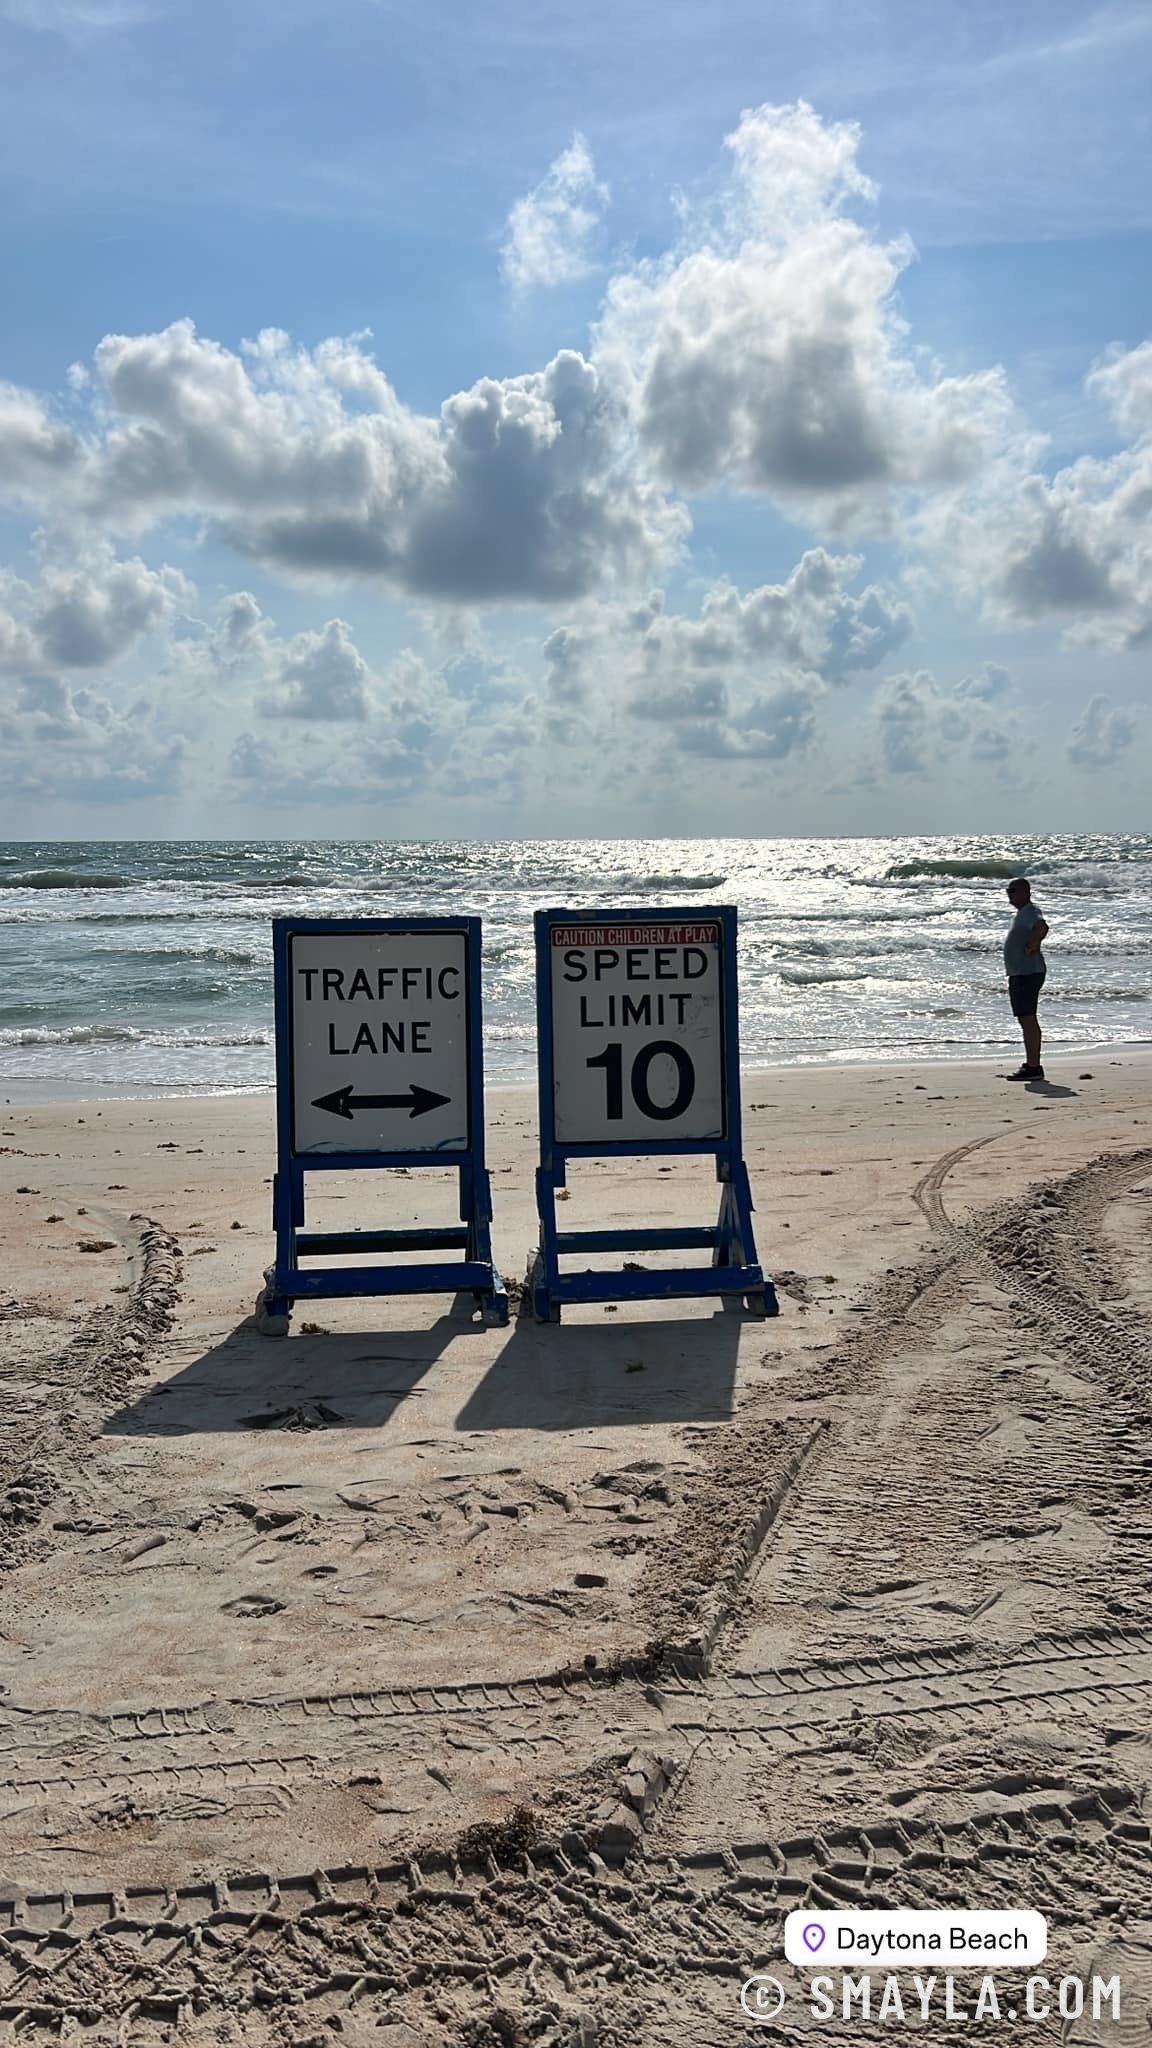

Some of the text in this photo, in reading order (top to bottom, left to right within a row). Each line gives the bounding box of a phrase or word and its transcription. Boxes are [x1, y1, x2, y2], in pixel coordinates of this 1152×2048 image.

[555, 927, 714, 945] CAUTION CHILDREN AT PLAY
[563, 947, 708, 982] SPEED
[298, 966, 460, 1000] TRAFFIC
[580, 993, 692, 1027] LIMIT
[328, 1021, 432, 1055] LANE
[586, 1040, 695, 1120] 10
